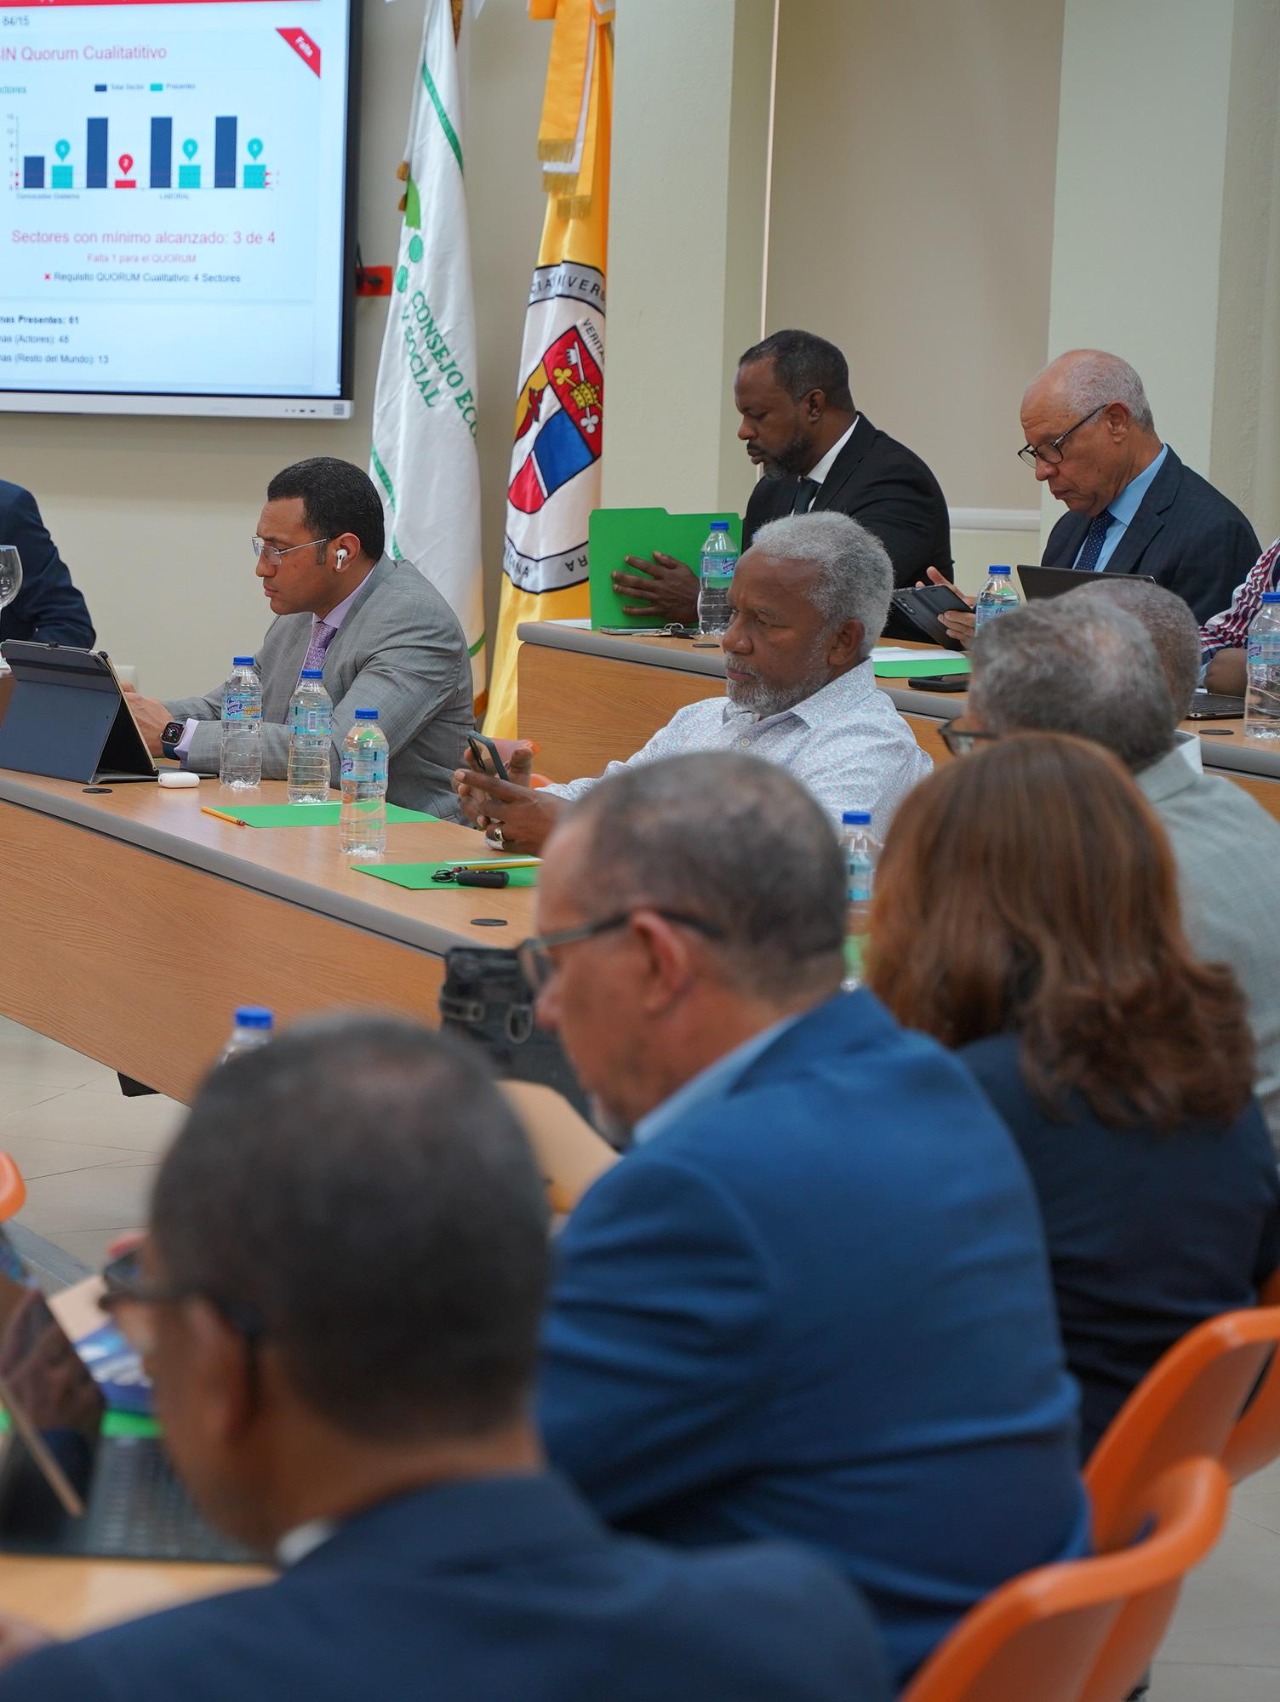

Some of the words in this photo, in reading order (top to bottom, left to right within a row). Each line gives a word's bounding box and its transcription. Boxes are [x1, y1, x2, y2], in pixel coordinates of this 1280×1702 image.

[21, 45, 79, 62] Quorum
[11, 230, 70, 244] Sectores
[73, 233, 98, 244] con
[154, 231, 229, 245] alcanzado:
[233, 230, 242, 245] 3
[245, 231, 263, 245] de
[119, 254, 139, 264] para
[202, 273, 241, 283] Sectores
[411, 290, 465, 389] CONSEJO
